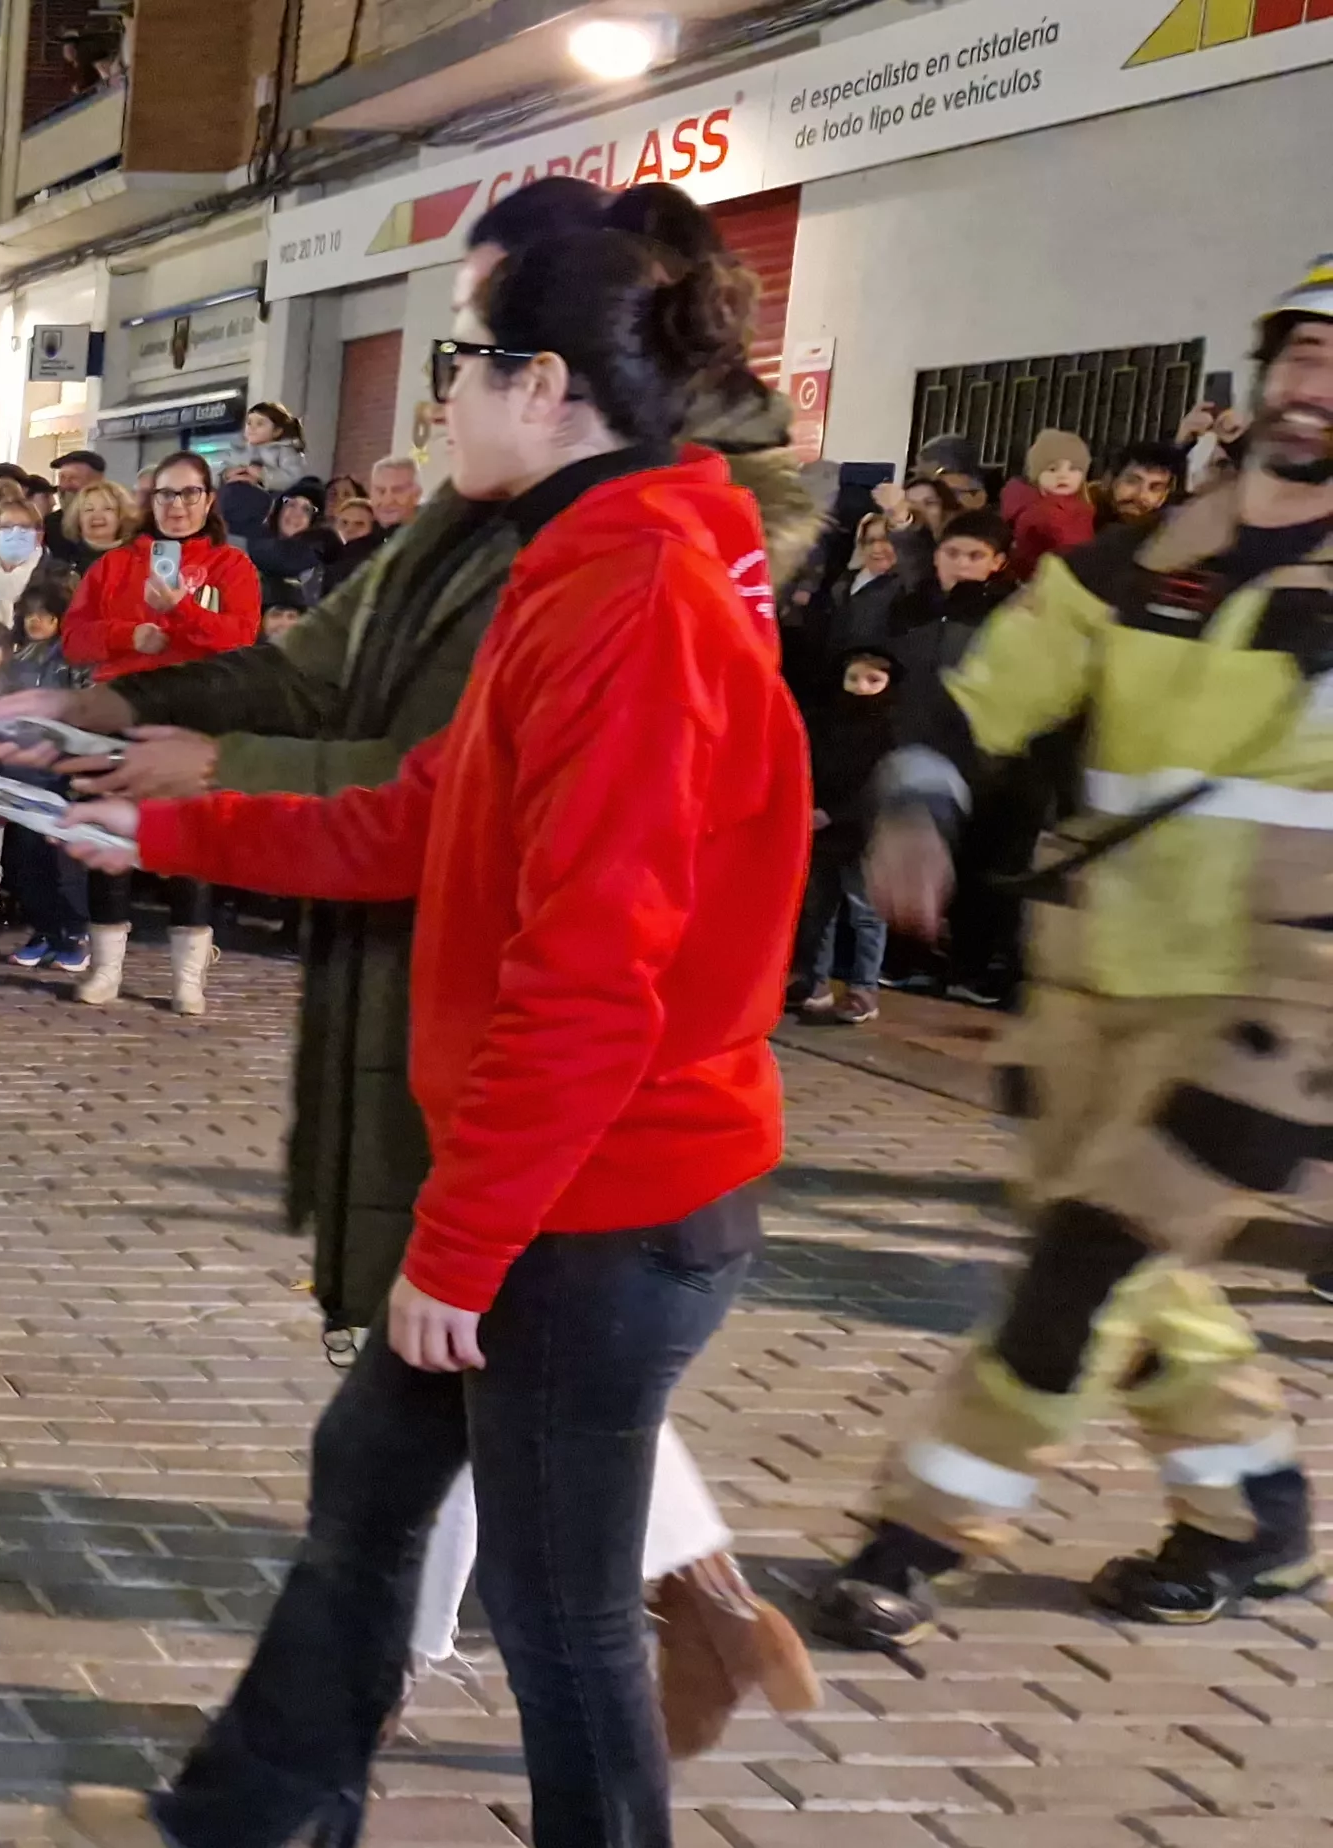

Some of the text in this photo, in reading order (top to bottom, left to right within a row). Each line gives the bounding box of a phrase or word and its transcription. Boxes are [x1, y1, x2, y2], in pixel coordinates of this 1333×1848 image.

[791, 16, 1060, 114] el especialista en cristalería
[795, 67, 1042, 149] de todo tipo de vehículos
[330, 229, 341, 252] 10
